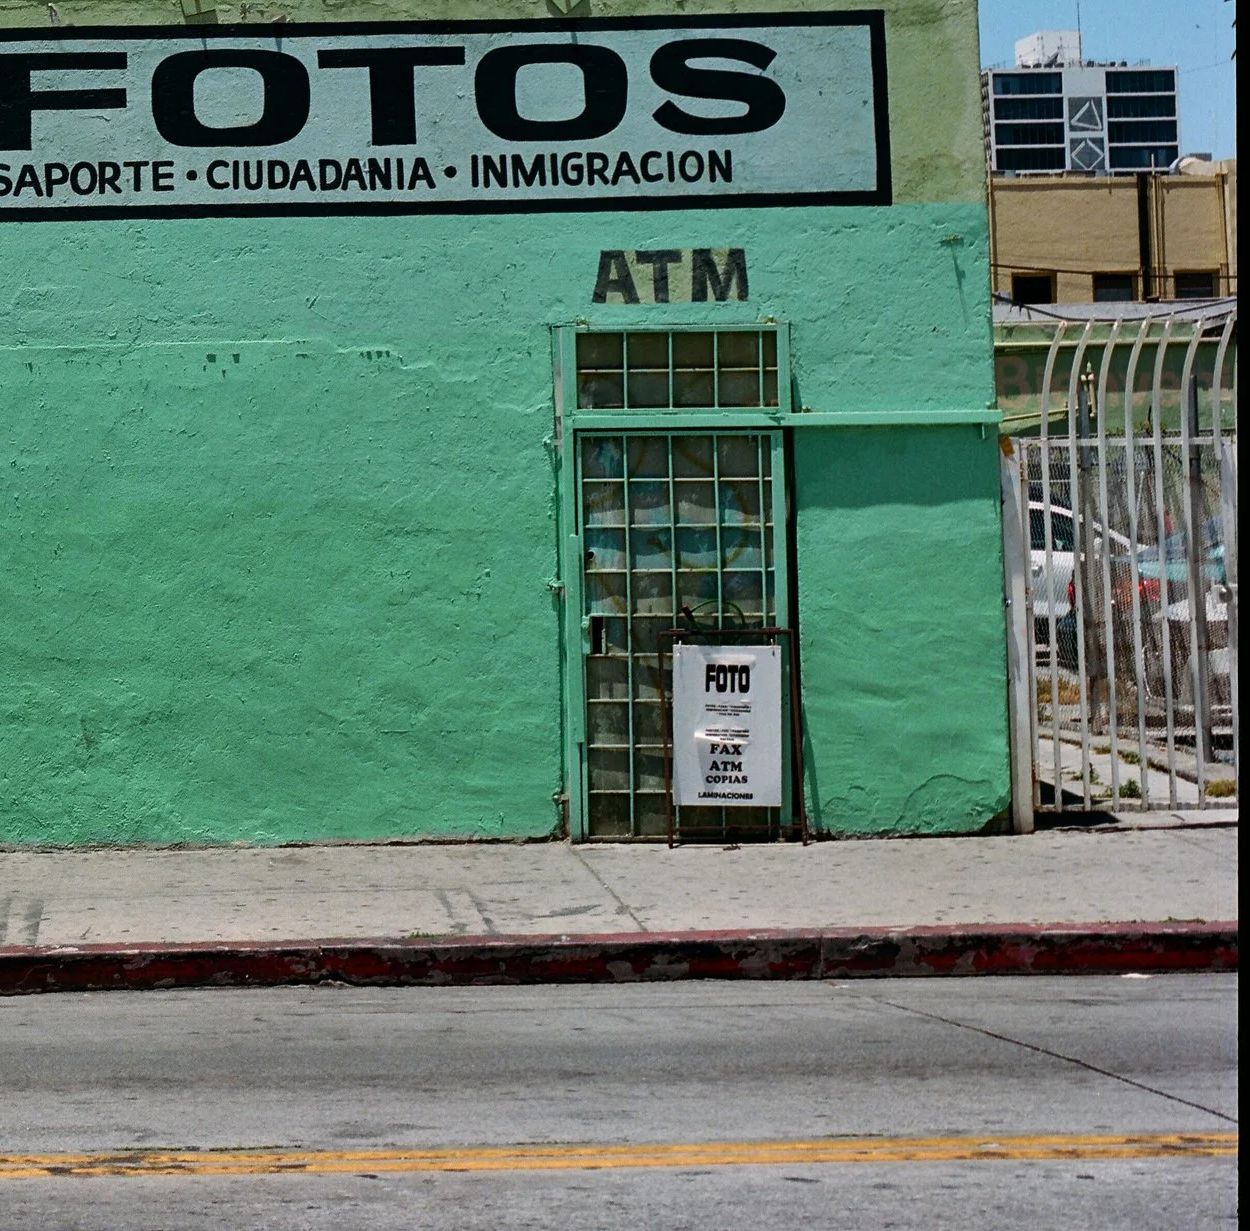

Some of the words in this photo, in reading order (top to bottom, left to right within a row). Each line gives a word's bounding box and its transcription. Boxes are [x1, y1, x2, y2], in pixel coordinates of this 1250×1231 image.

[207, 157, 437, 192] CIUDADANIA
[471, 149, 733, 189] INMIGRACION
[592, 248, 750, 305] ATM
[705, 664, 750, 694] FOTO
[710, 743, 742, 755] FAX
[709, 760, 743, 772] ATM
[705, 775, 748, 784] COPIAS
[698, 791, 754, 800] LAMINACIONES
